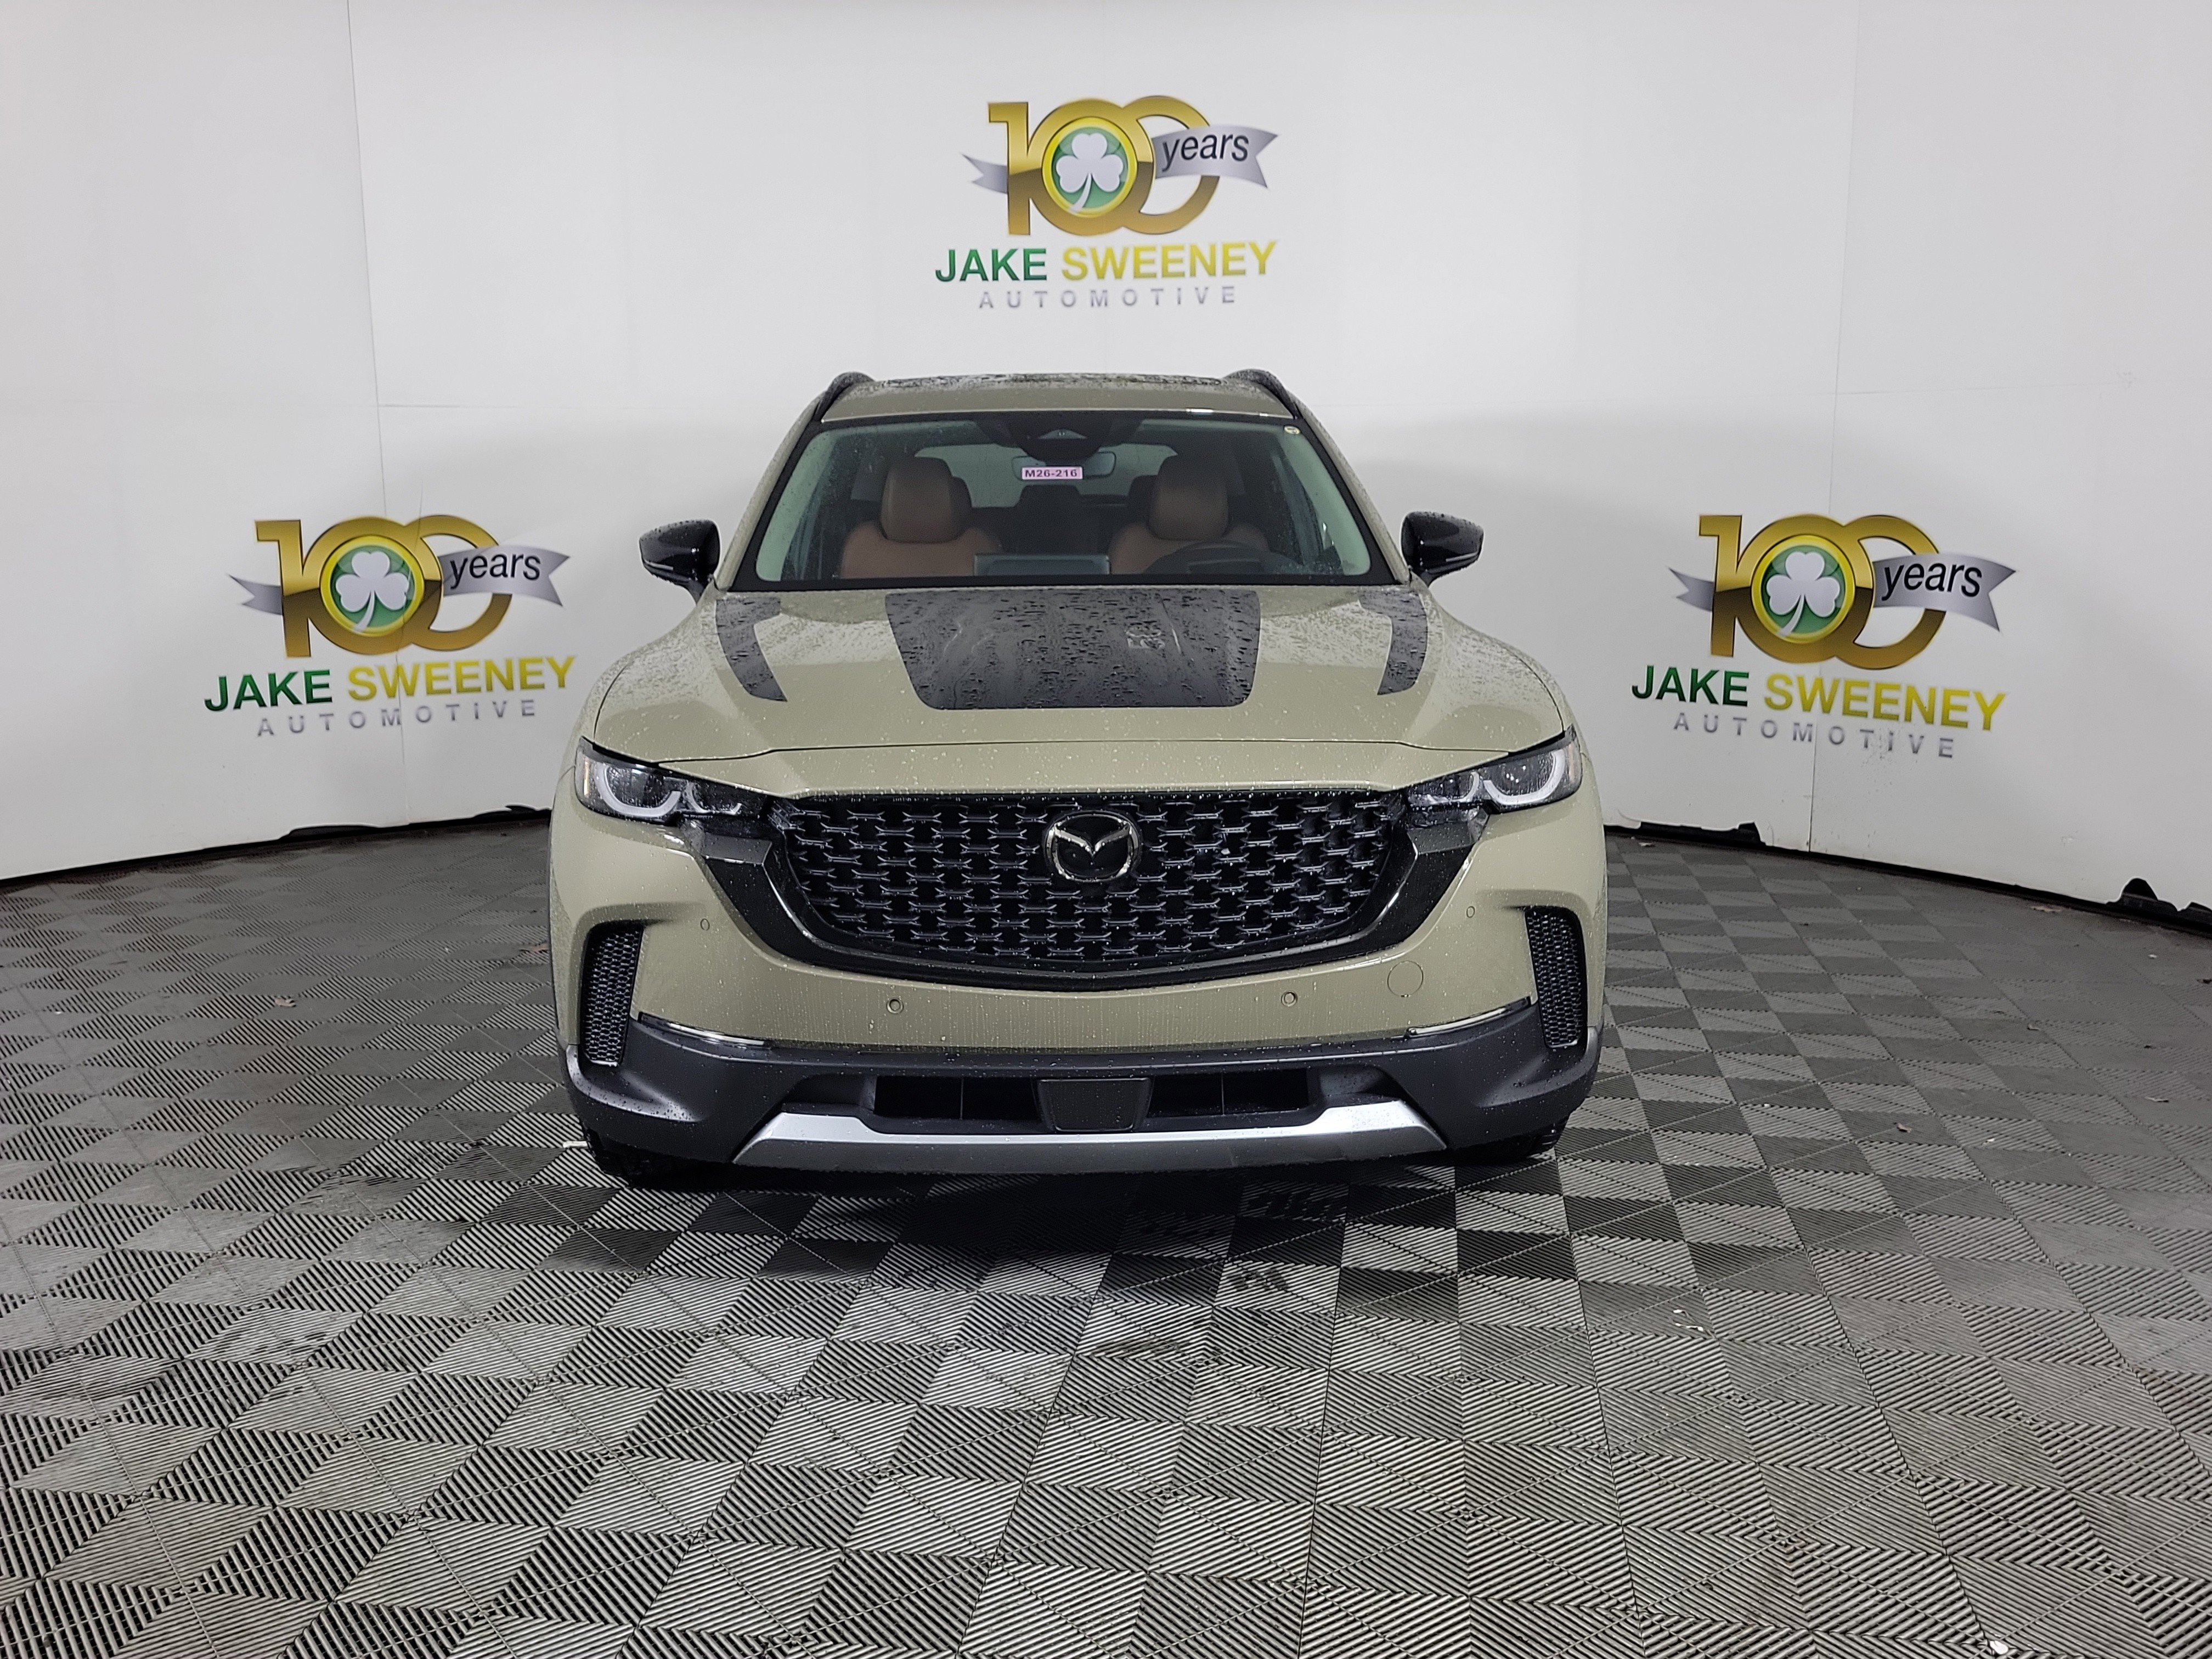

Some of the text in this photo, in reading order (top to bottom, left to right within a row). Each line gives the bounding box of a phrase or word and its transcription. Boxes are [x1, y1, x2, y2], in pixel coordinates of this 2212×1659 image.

[1161, 132, 1249, 171] years
[935, 240, 1277, 282] JAKE SWEENEY
[979, 286, 1236, 310] AUTOMOTIVE
[1025, 469, 1077, 478] M26-216
[449, 554, 541, 589] years
[1881, 562, 1982, 601] years
[204, 656, 576, 712] JAKE SWEENEY
[1632, 665, 2006, 731] JAKE SWEENEY
[257, 699, 536, 737] AUTOMOTIVE
[1673, 713, 1954, 759] AUTOMOTIVE
